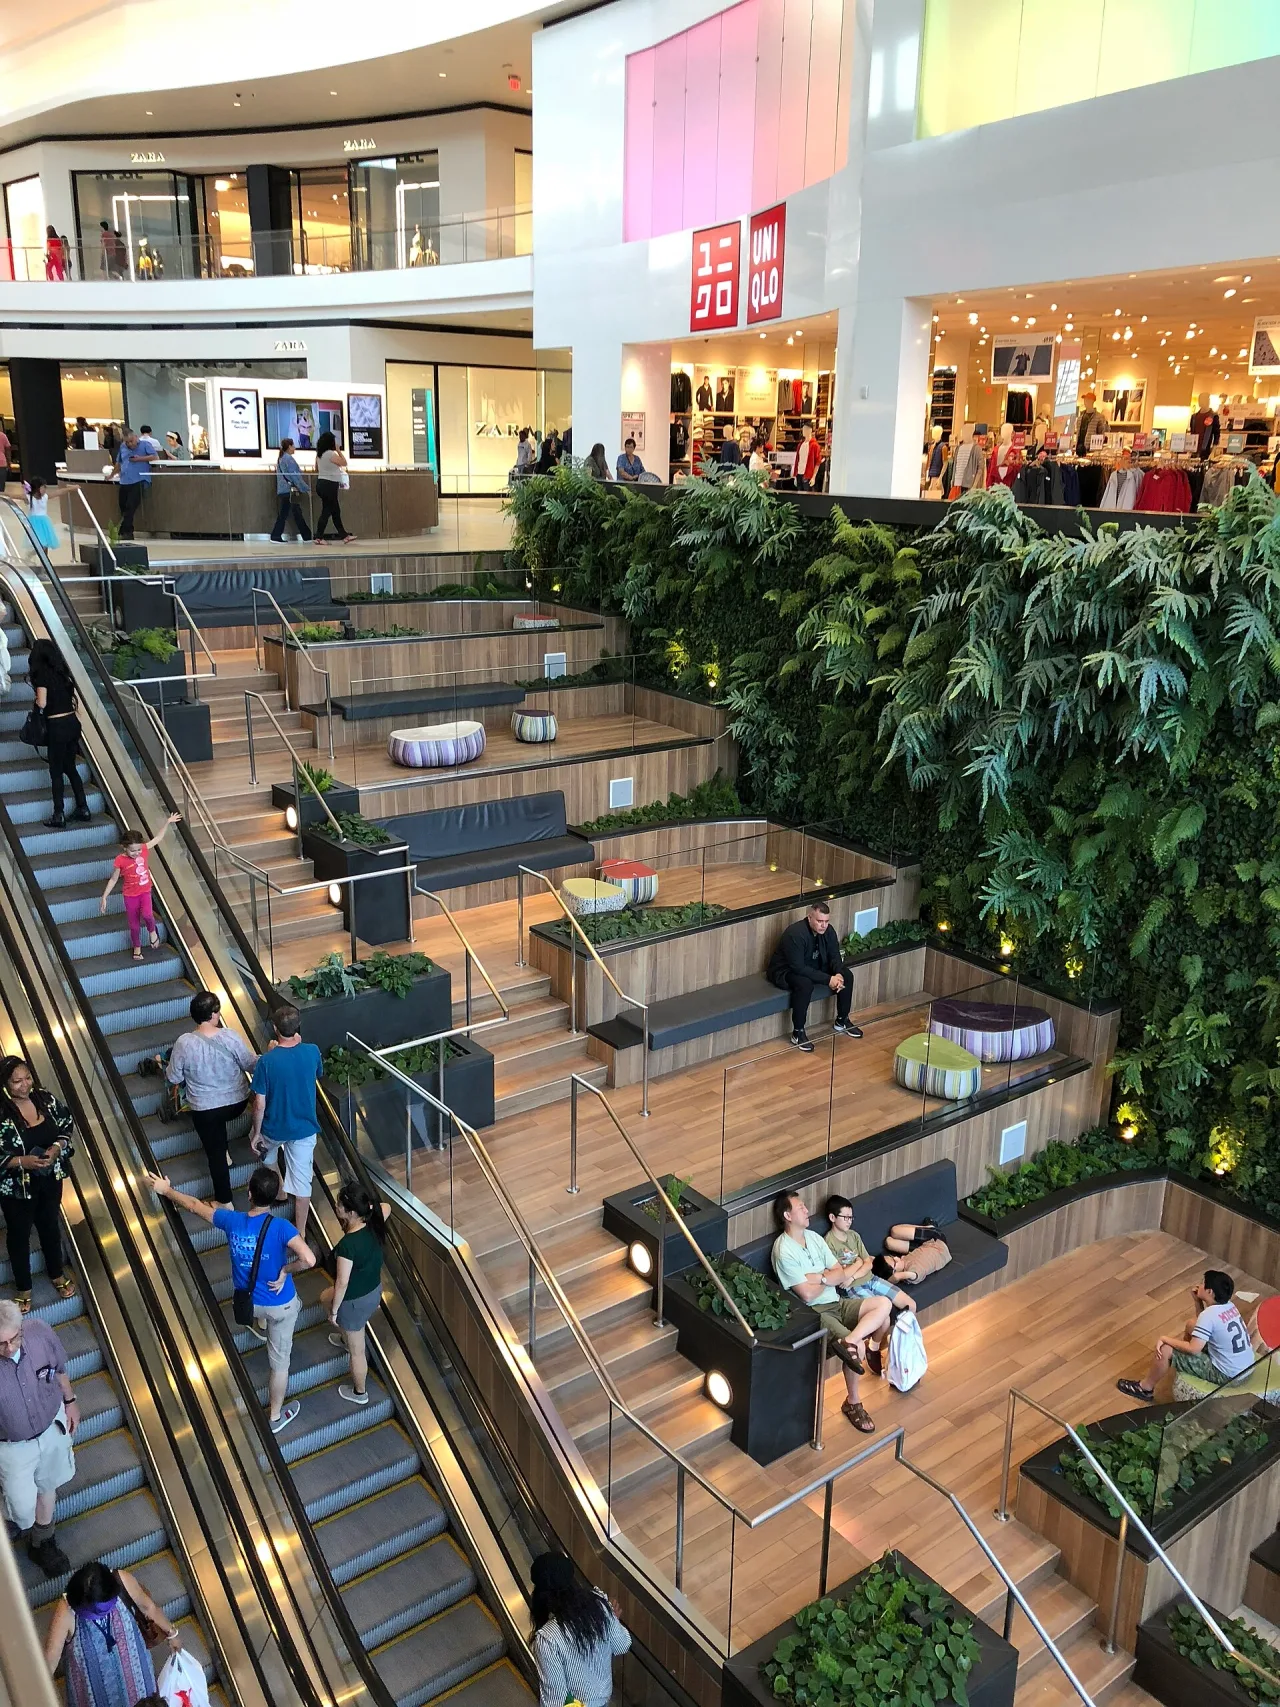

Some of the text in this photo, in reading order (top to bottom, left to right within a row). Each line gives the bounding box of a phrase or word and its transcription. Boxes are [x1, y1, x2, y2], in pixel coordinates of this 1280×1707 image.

[343, 138, 376, 152] ZARA
[131, 152, 165, 164] ZARA
[753, 221, 779, 265] UNI
[751, 267, 779, 314] QLO
[273, 340, 308, 352] ZARA
